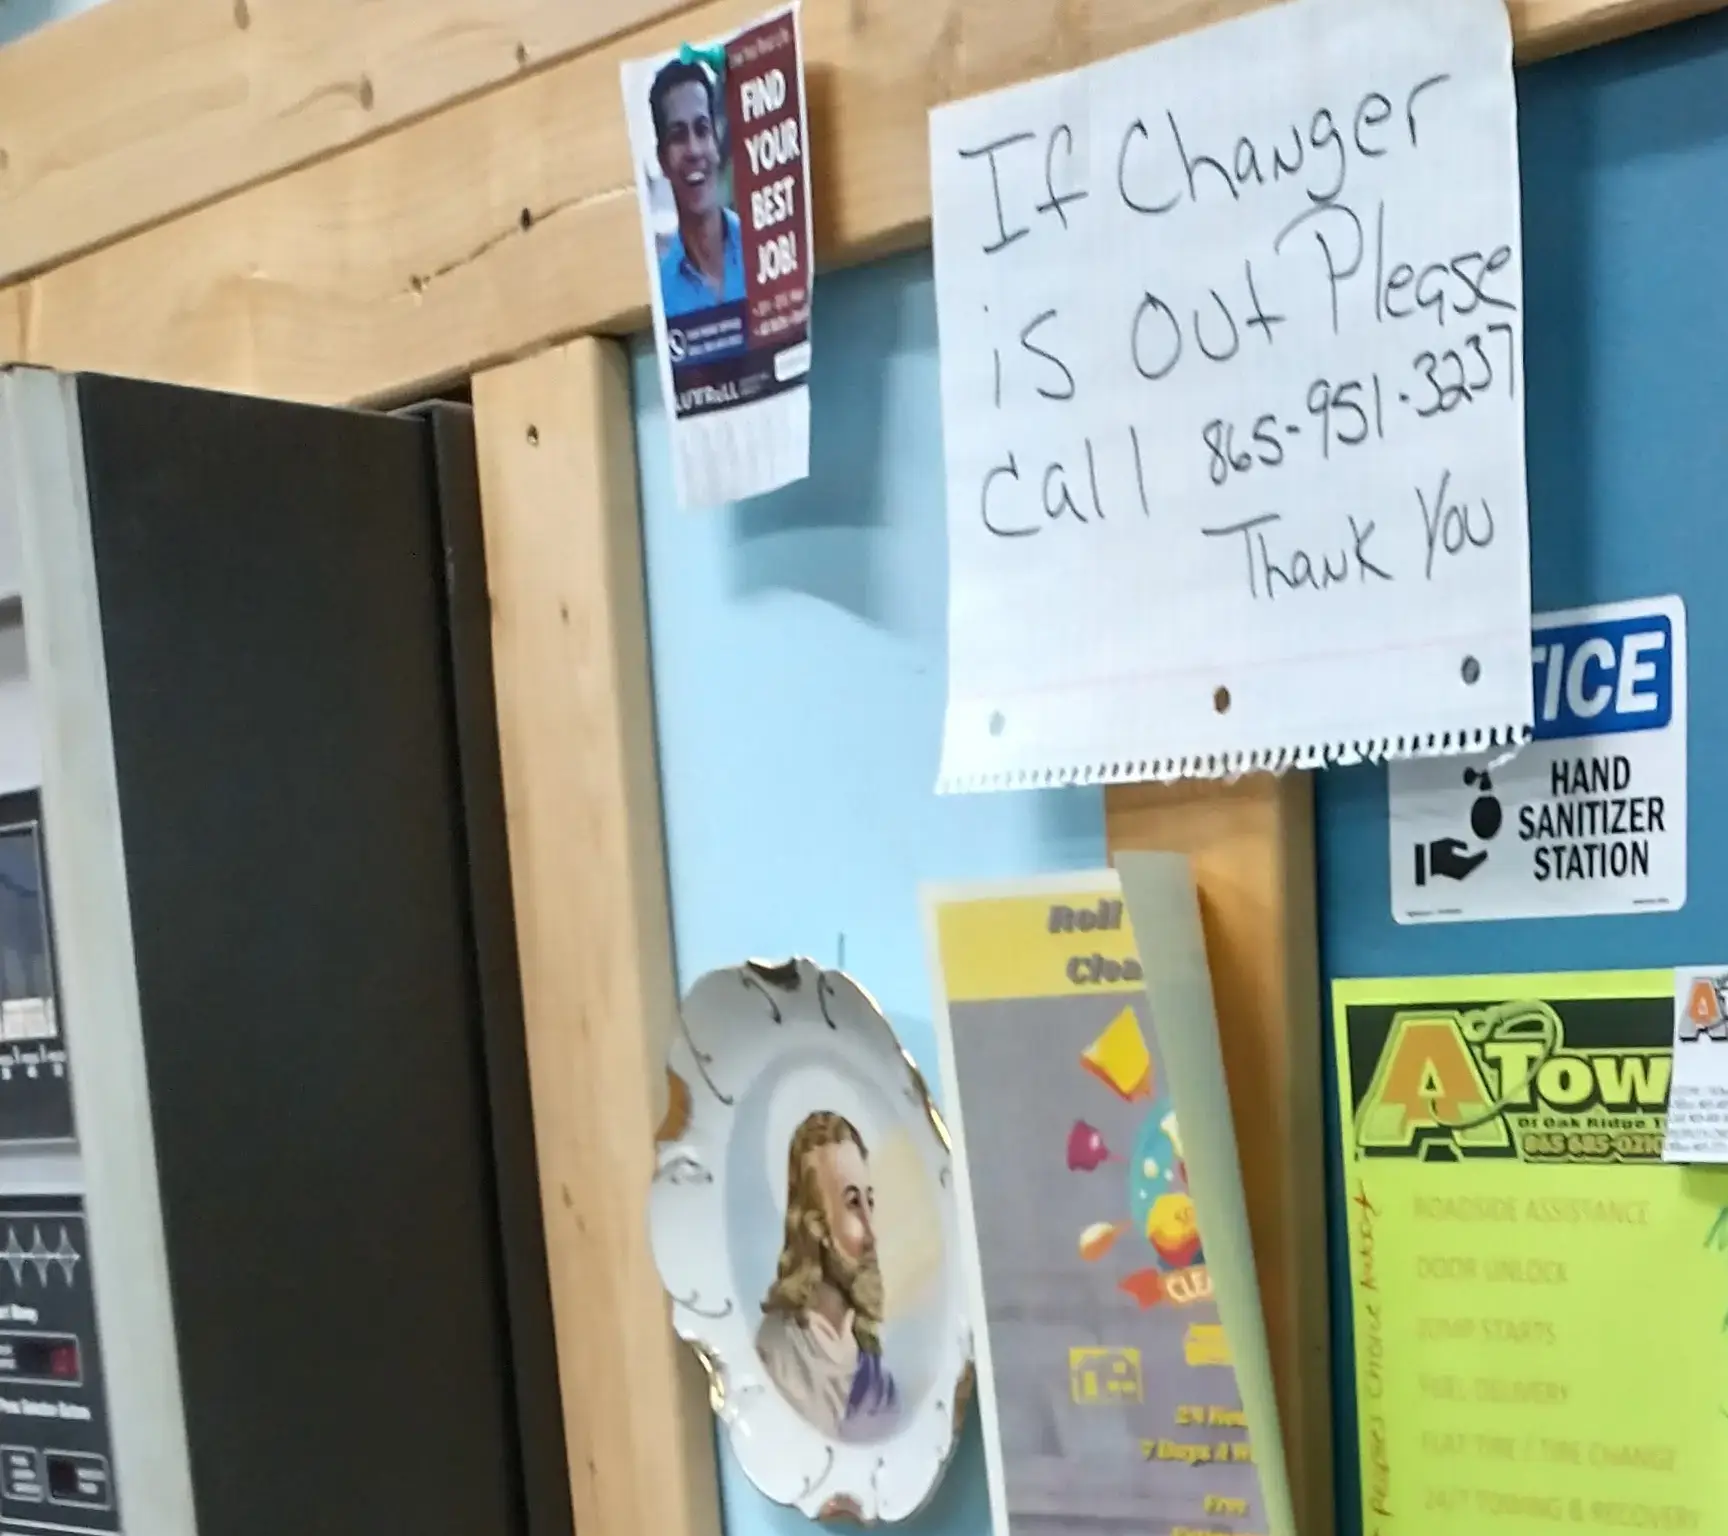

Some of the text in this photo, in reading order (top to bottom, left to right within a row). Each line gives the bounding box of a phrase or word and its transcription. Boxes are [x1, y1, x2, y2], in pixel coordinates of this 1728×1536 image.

[740, 68, 787, 123] FIND
[744, 117, 800, 176] YOUR
[958, 74, 1452, 254] If Changer
[751, 177, 796, 230] BEST
[756, 234, 797, 285] JOB!
[983, 304, 1075, 408] is
[1275, 201, 1517, 335] Please
[1201, 514, 1395, 600] Thank
[1551, 755, 1631, 797] HAND
[1518, 795, 1667, 841] SANITIZER
[1533, 840, 1650, 881] STATION
[1048, 898, 1123, 934] Roll
[1543, 1115, 1581, 1130] Oak
[1586, 1117, 1647, 1134] Ridge
